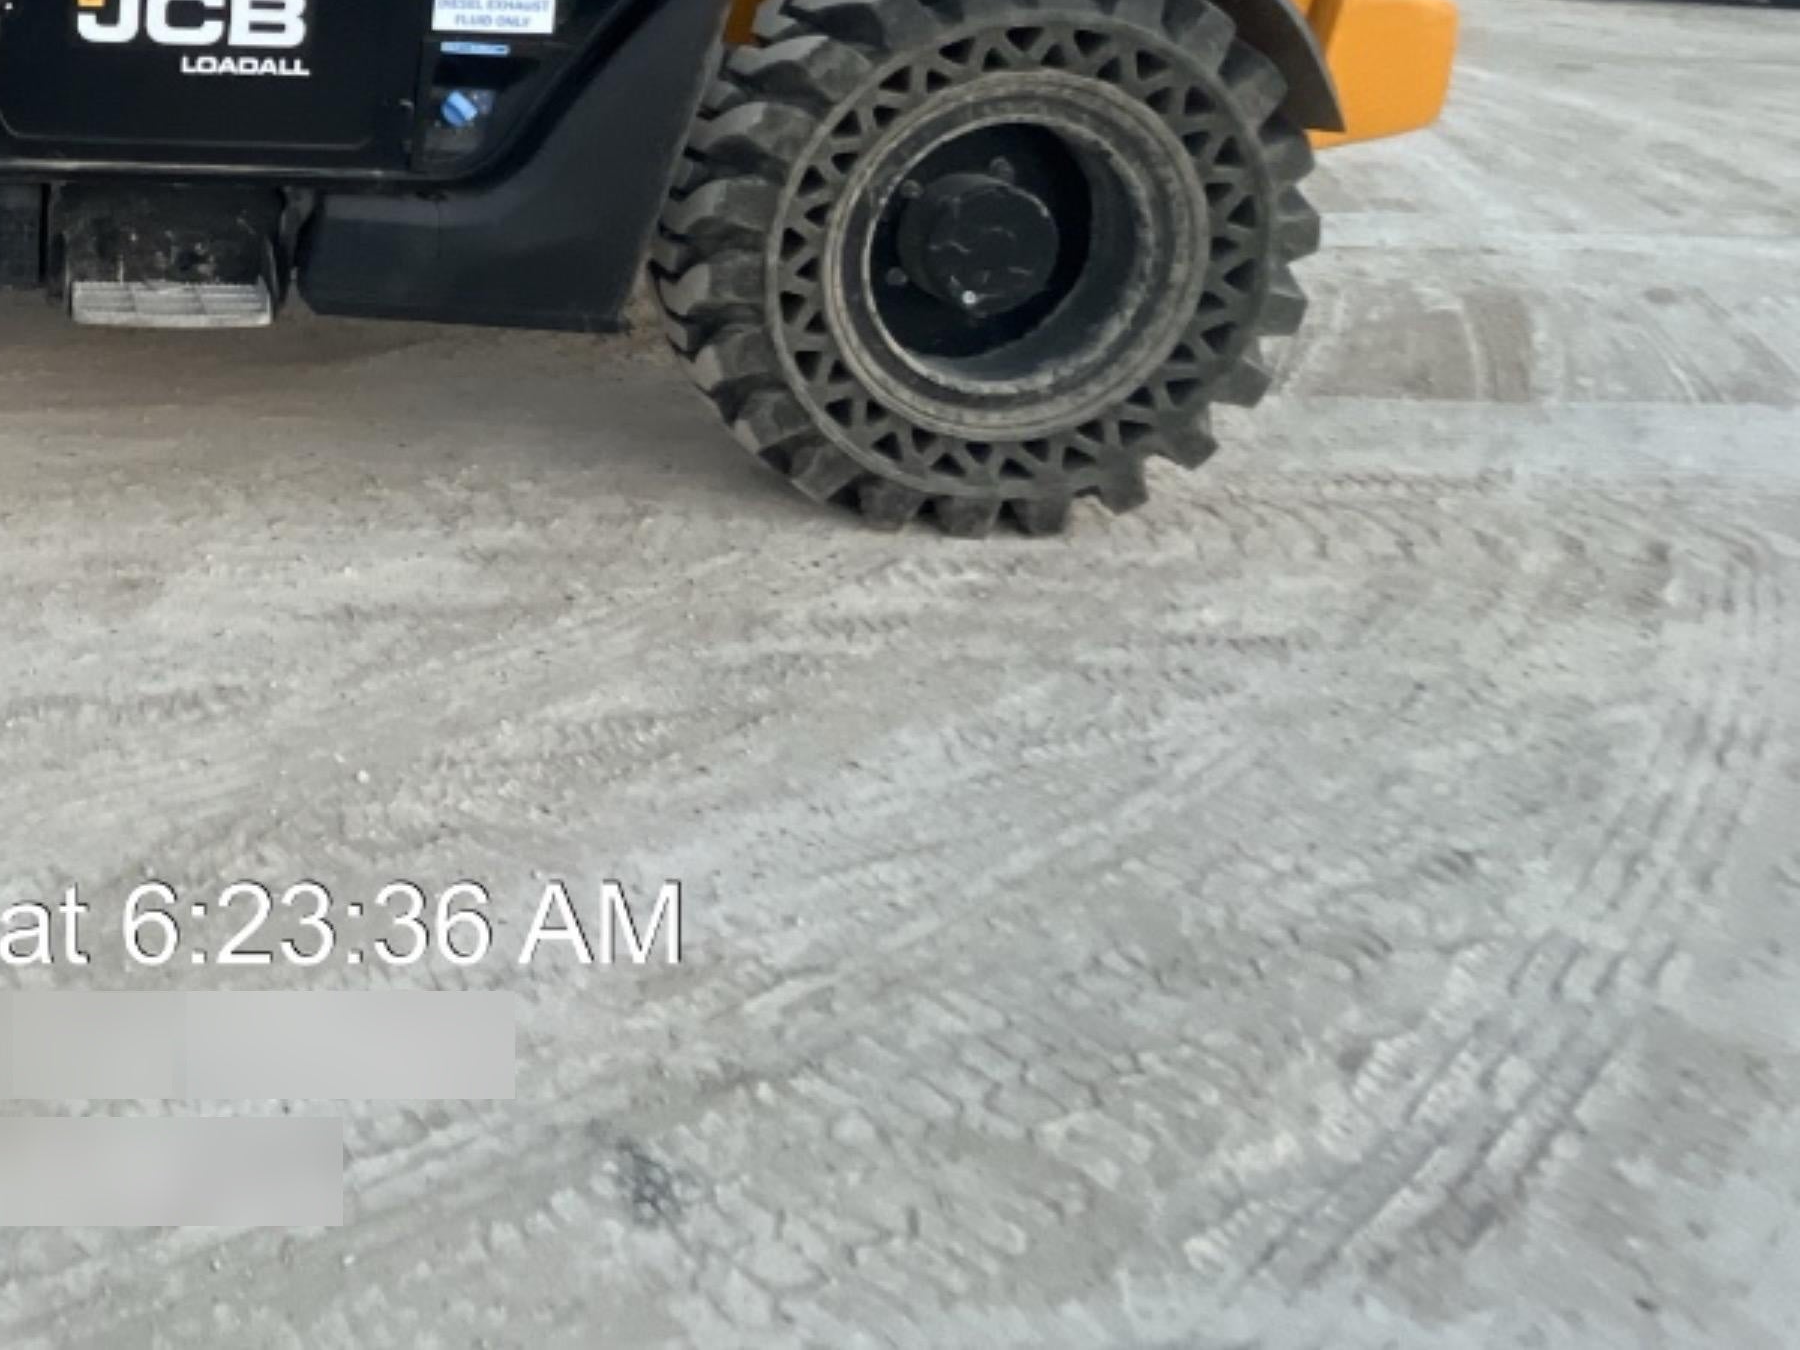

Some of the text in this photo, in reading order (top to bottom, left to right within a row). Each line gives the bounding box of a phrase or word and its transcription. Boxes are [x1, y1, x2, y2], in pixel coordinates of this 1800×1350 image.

[486, 0, 550, 12] EXHAUST
[455, 13, 531, 28] FLUID ONLY
[180, 55, 311, 76] LOADALL
